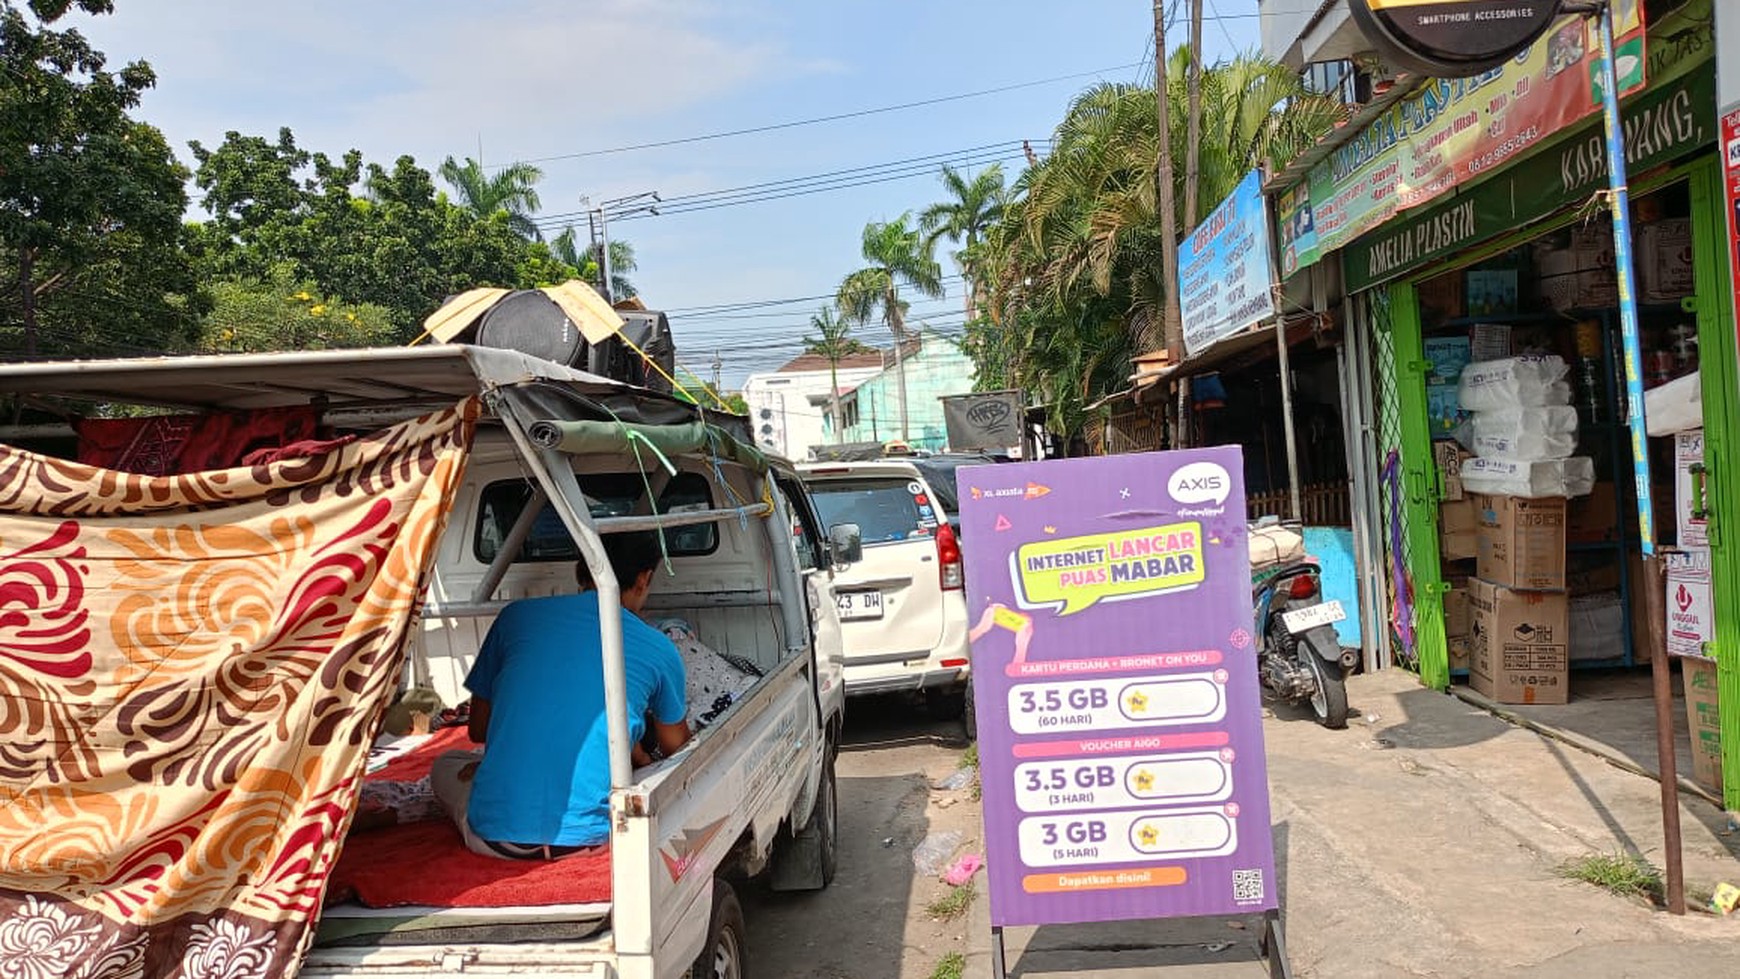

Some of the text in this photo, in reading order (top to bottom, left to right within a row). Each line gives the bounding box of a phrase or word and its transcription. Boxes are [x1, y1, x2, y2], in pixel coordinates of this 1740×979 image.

[1418, 8, 1533, 25] SMARTPHONE ACCESSORIES
[1369, 229, 1413, 278] AMELIA
[1177, 476, 1222, 491] AXIS
[1027, 530, 1196, 572] INTERNET LANCAR
[1060, 553, 1195, 588] PUAS MABAR
[1021, 663, 1056, 674] KARTU
[1059, 660, 1109, 672] PERDANA
[1165, 655, 1182, 664] ON
[1184, 653, 1207, 663] YOU
[1019, 687, 1108, 712] 3.5 GB
[1038, 714, 1092, 727] (60 HARI)
[1080, 737, 1160, 751] VOUCHER AIGO
[1025, 766, 1115, 791] 3.5 GB
[1048, 793, 1094, 805] (3 HARI)
[1041, 821, 1107, 845] 3 GB
[1053, 847, 1098, 860] (5 HARI)
[1059, 871, 1152, 888] Dapatkan disini!
